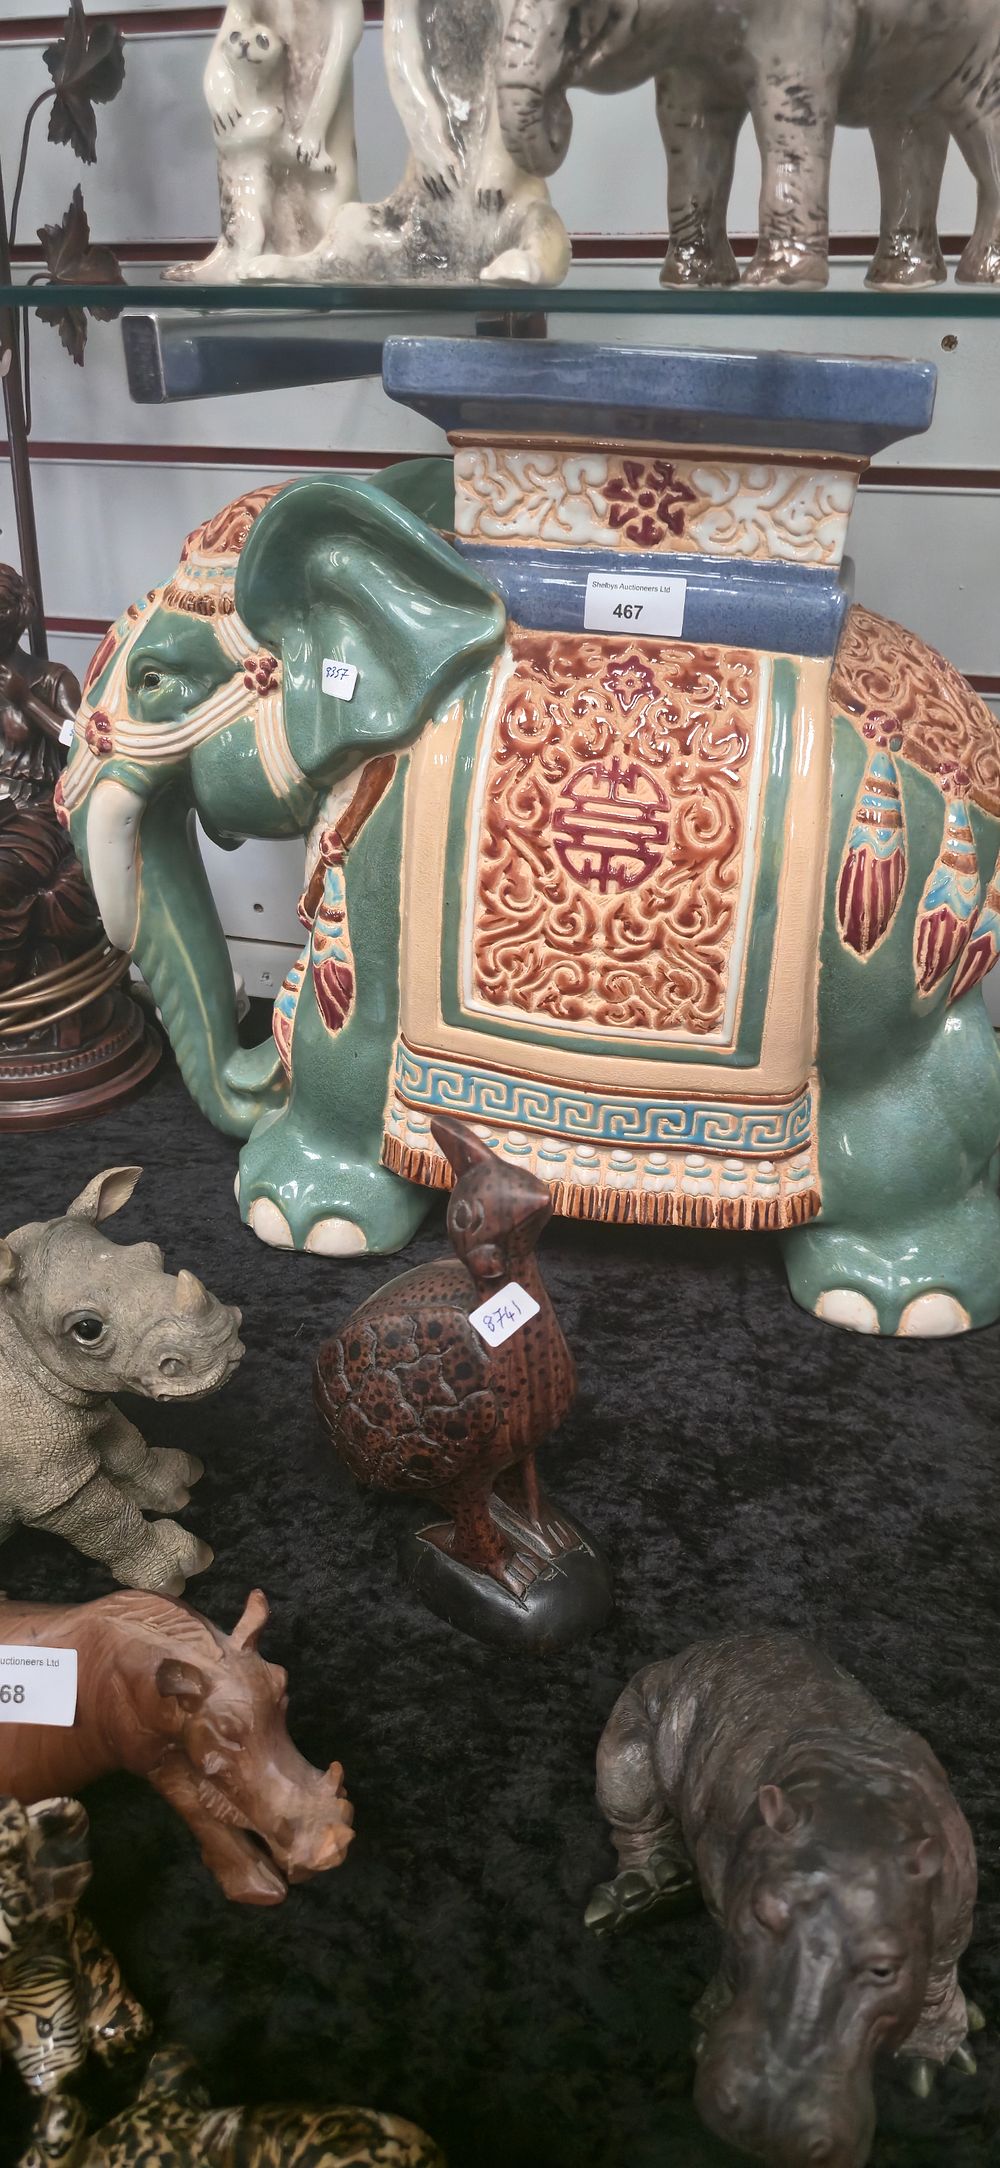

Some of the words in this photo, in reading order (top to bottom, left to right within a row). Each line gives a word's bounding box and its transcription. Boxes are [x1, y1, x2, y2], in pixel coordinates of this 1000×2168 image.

[592, 581, 618, 590] Shelbys
[619, 583, 658, 592] Auctioneers
[613, 604, 643, 620] 467
[483, 1300, 521, 1333] 8741
[0, 1656, 44, 1666] uctioneers
[46, 1658, 60, 1667] Ltd
[0, 1684, 25, 1704] 68
